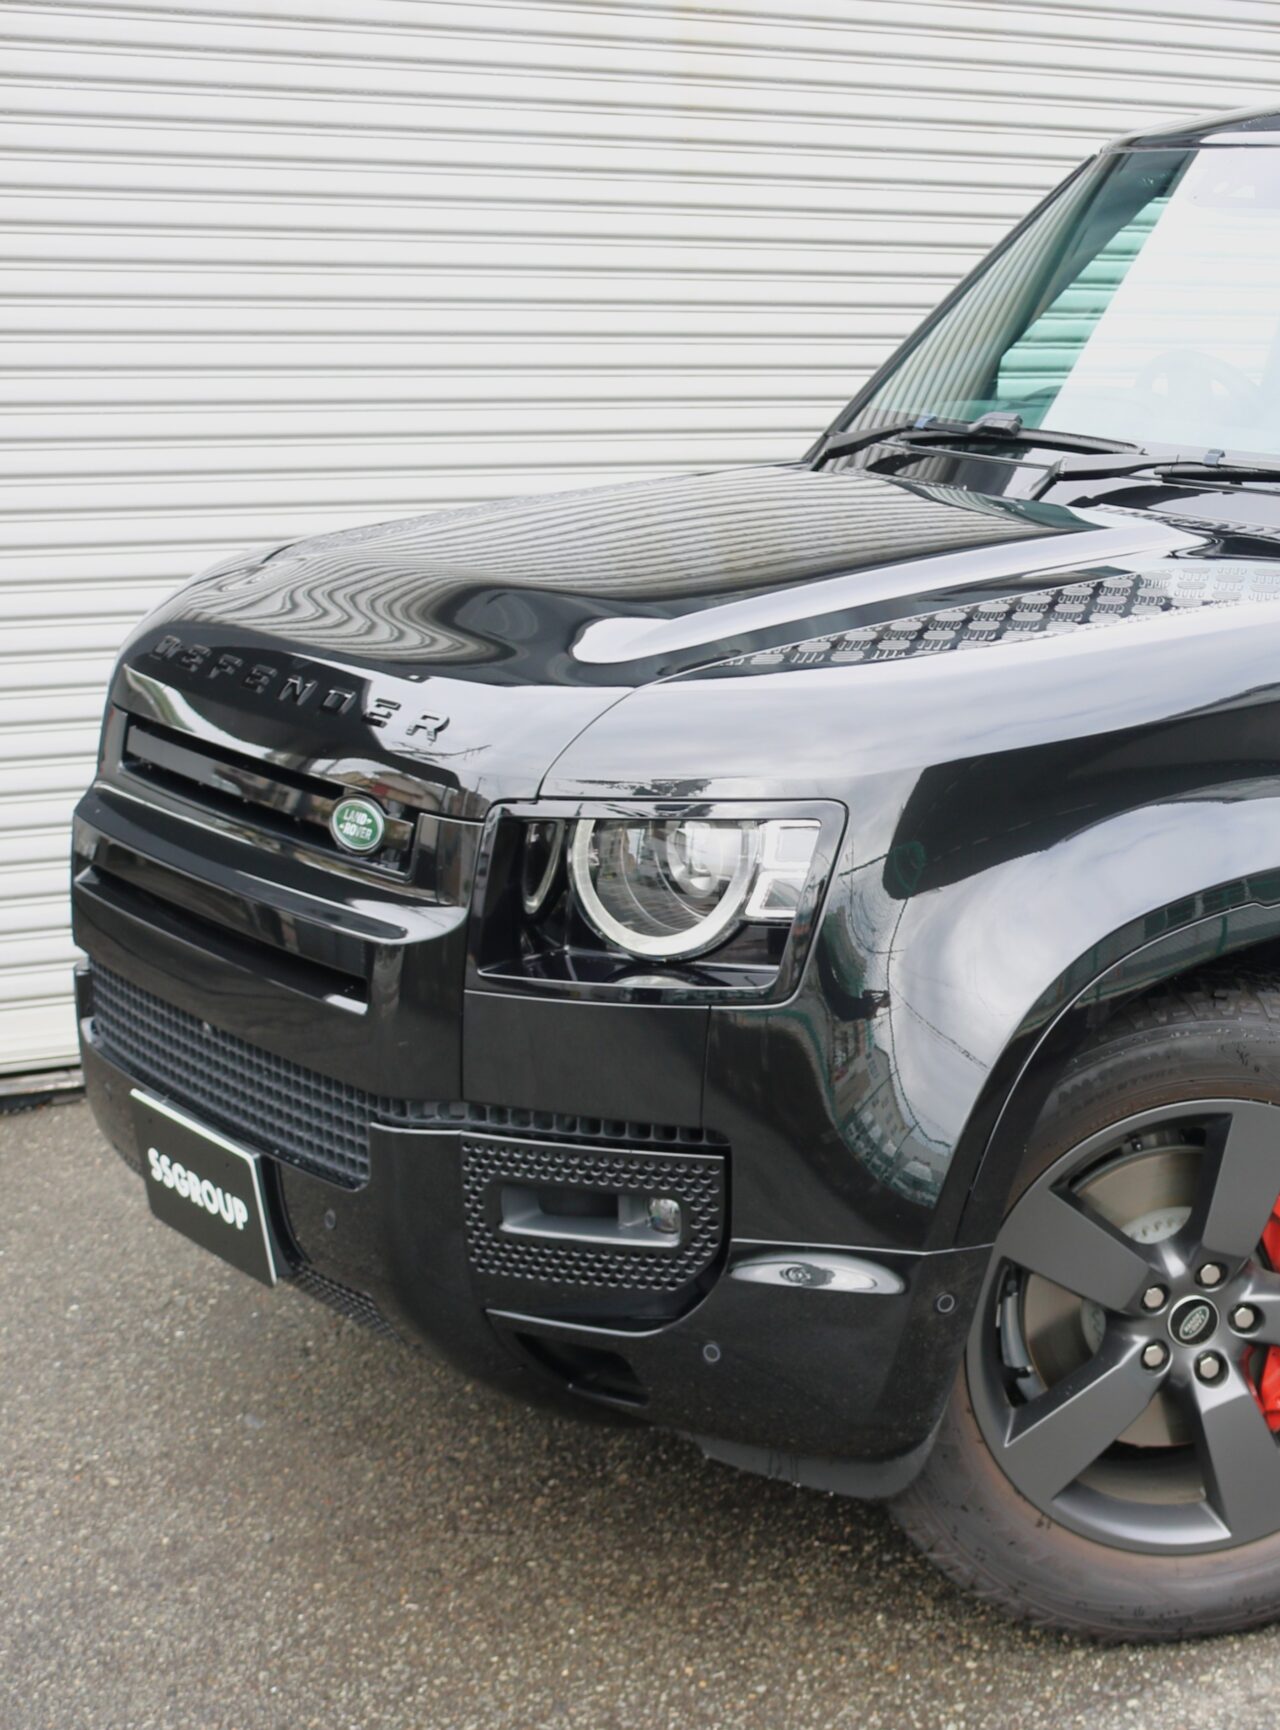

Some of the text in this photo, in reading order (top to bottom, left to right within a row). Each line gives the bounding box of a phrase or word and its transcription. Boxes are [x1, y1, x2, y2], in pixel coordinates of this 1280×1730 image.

[149, 634, 450, 746] DEFENDER
[343, 808, 368, 826] LAND
[343, 822, 373, 841] ROVER
[148, 1147, 248, 1231] SSGROUP
